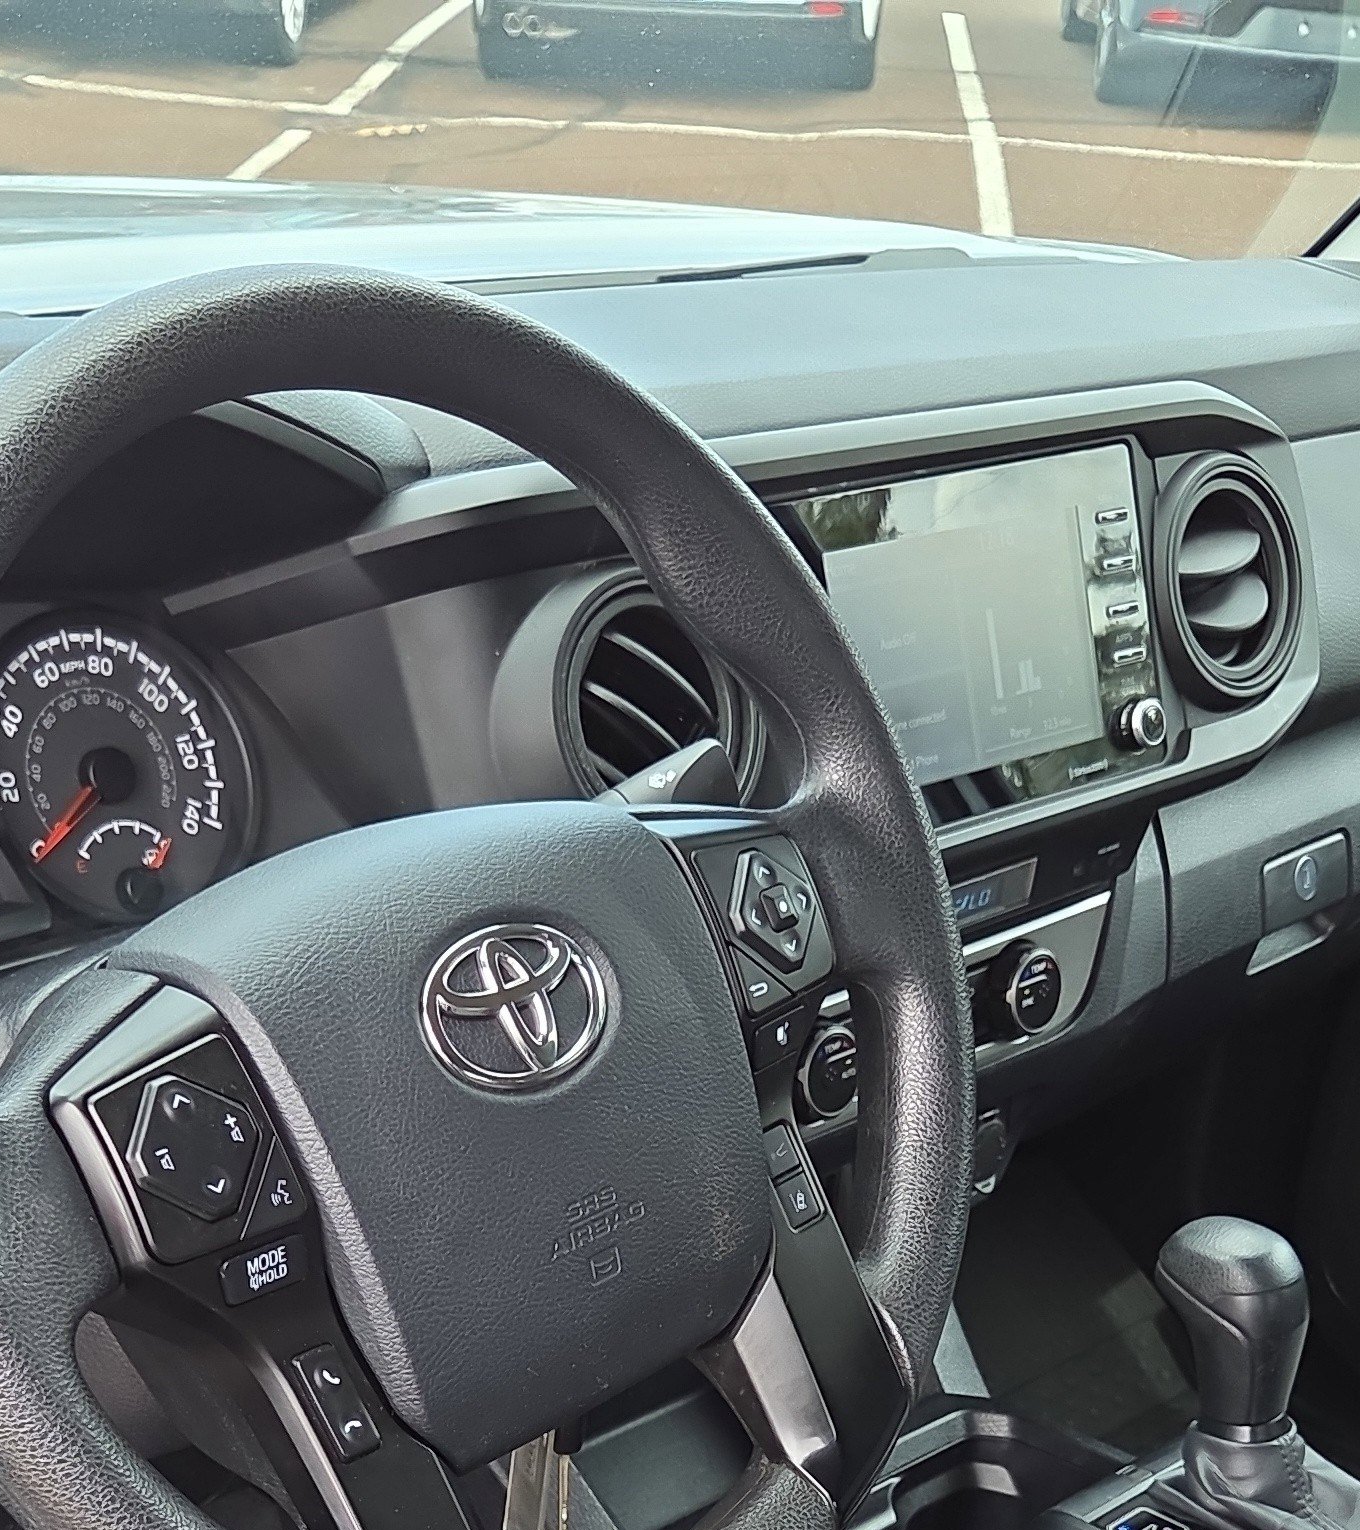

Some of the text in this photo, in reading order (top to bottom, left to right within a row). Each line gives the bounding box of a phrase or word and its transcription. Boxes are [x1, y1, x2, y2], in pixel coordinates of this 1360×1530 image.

[32, 660, 61, 689] 60
[86, 654, 114, 677] 80
[138, 677, 169, 714] 100
[0, 704, 23, 739] 40
[175, 733, 199, 771] 120
[181, 797, 202, 836] 140
[246, 1245, 288, 1277] MODE
[258, 1263, 288, 1287] HOLD
